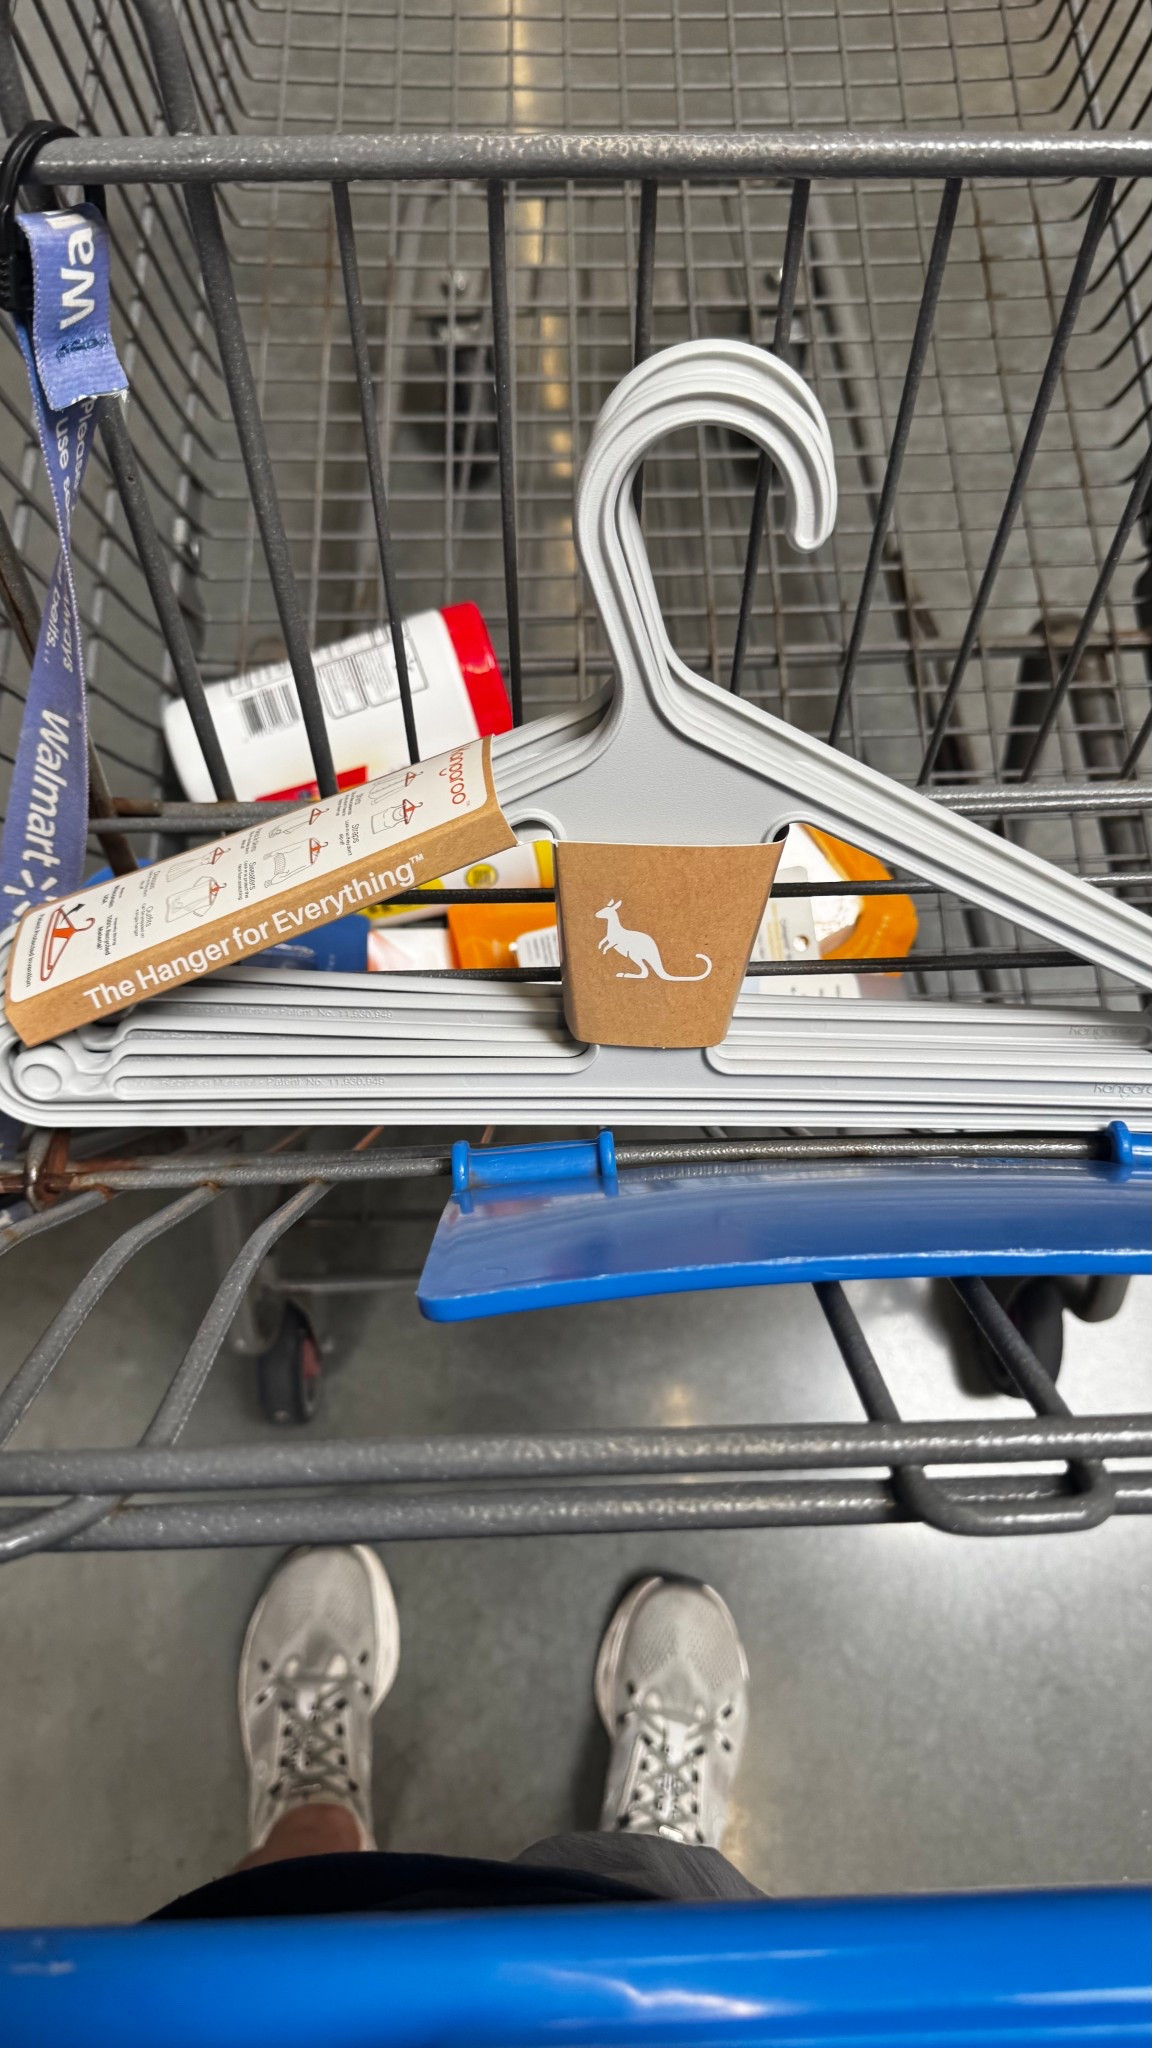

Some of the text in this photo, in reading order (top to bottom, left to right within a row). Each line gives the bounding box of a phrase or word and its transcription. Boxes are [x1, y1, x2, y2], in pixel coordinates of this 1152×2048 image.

[56, 416, 69, 471] use
[22, 709, 70, 868] Walmart
[83, 978, 136, 1009] The
[136, 937, 230, 990] Hanger
[231, 921, 269, 952] for
[266, 1076, 302, 1086] Patent
